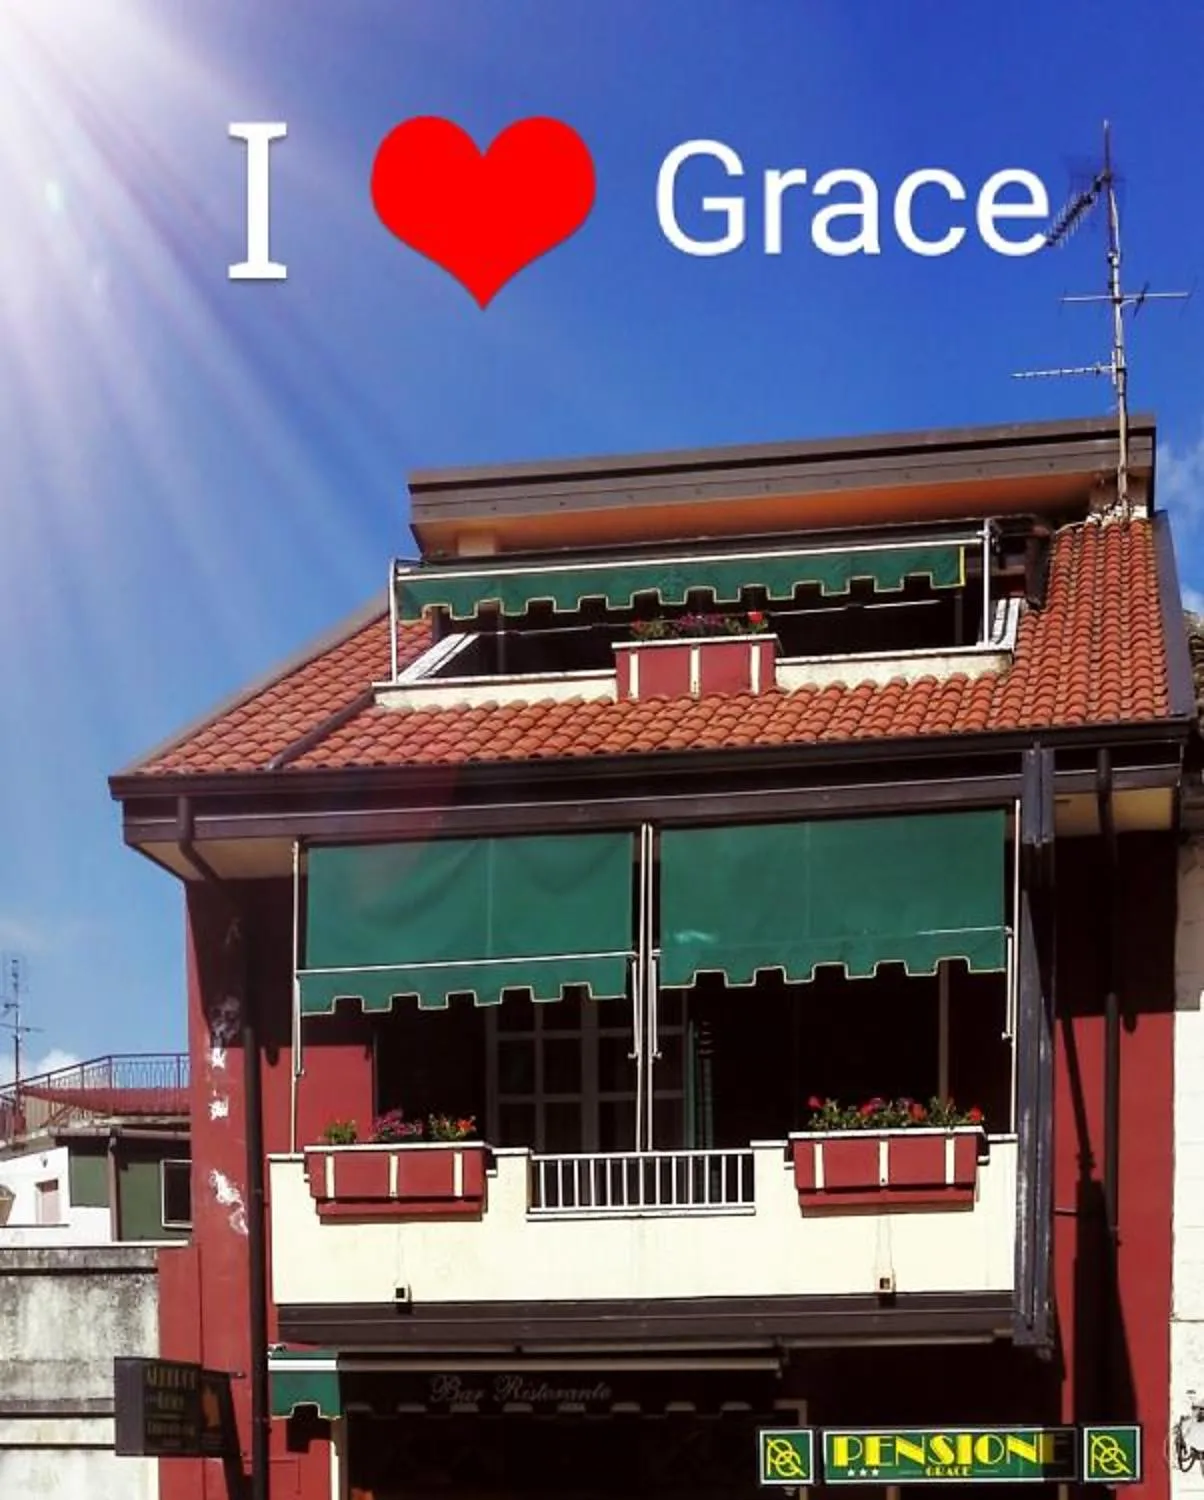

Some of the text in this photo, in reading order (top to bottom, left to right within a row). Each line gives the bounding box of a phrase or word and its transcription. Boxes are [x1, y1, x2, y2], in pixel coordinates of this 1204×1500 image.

[430, 1374, 613, 1403] Bar Ristorante
[832, 1433, 1070, 1468] PENSIONE
